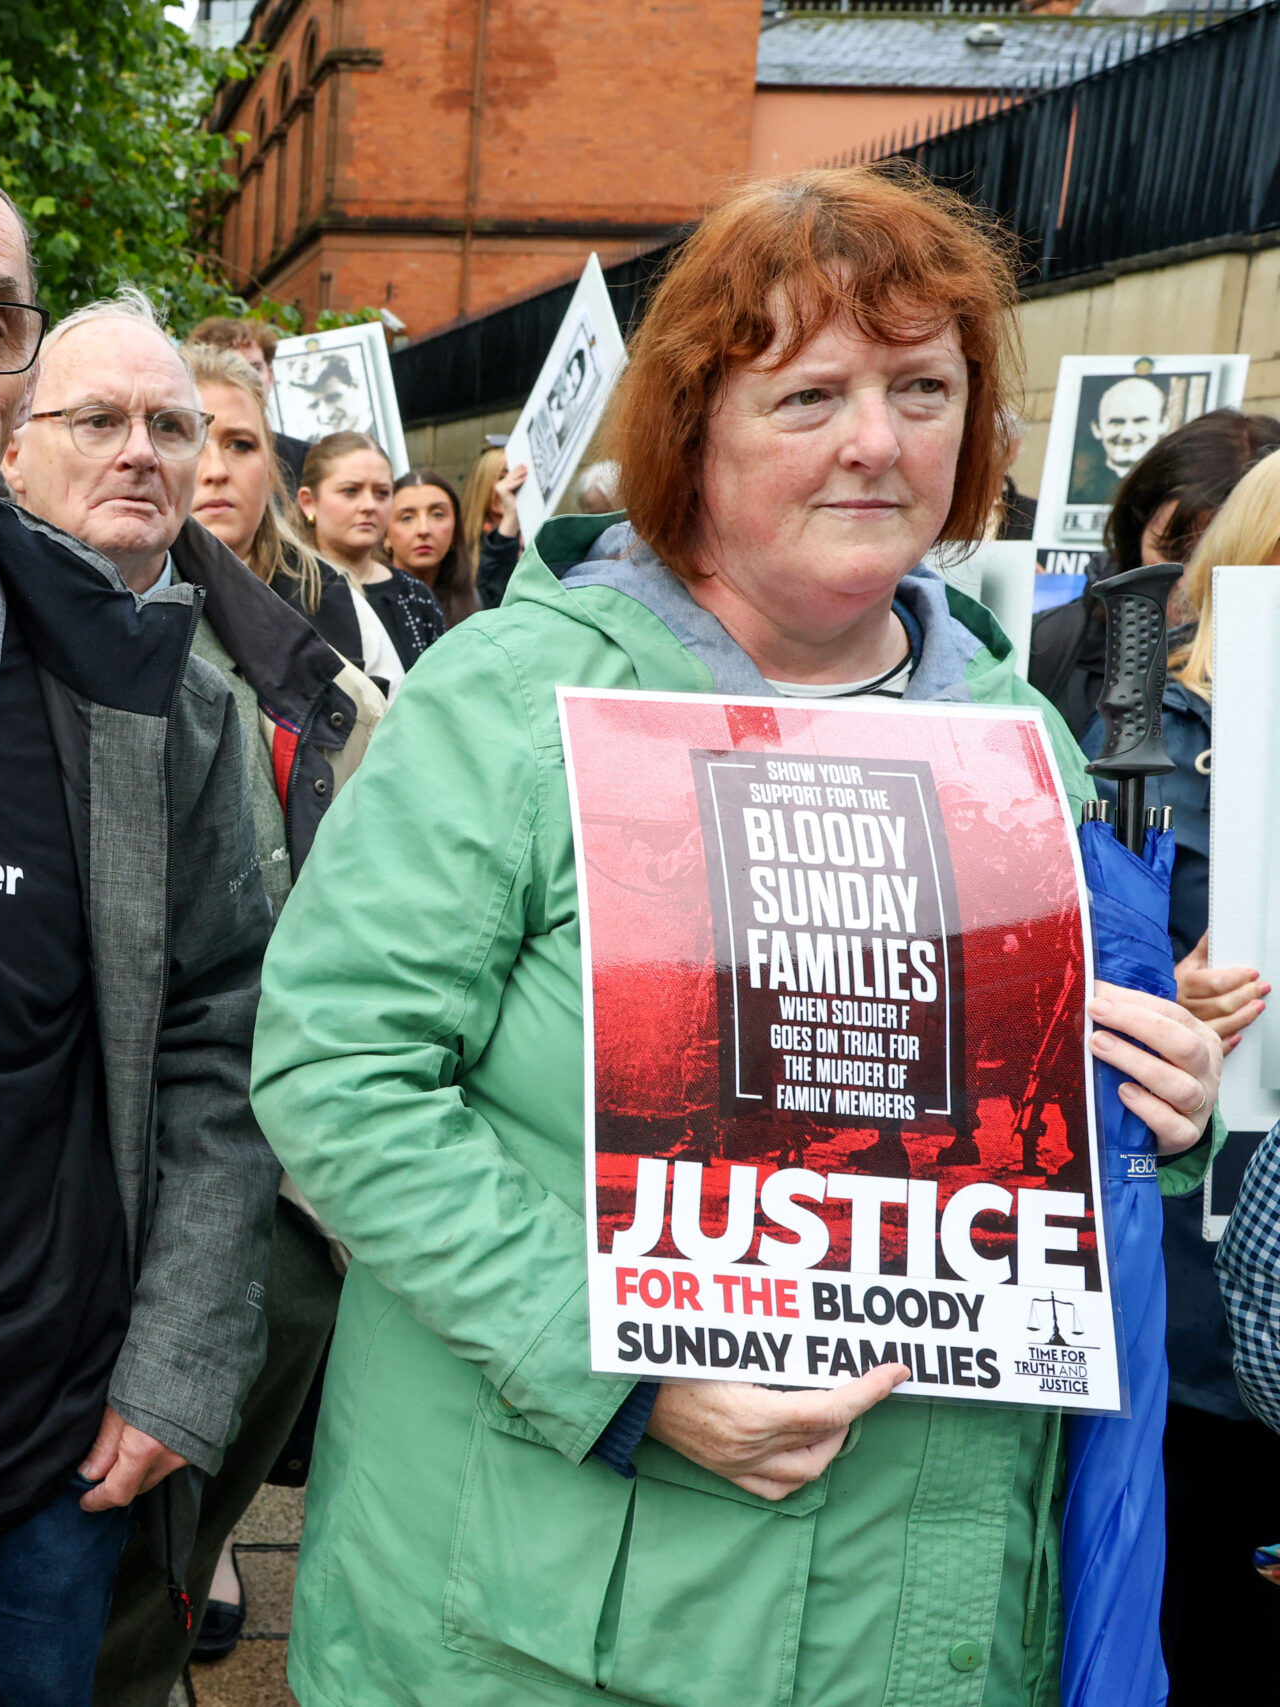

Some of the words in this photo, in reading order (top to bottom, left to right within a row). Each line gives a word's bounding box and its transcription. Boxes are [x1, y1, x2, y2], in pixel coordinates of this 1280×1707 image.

[766, 761, 815, 784] SHOW
[818, 764, 863, 786] YOUR
[749, 783, 821, 808] SUPPORT
[827, 787, 856, 809] FOR
[859, 789, 890, 811] THE
[742, 808, 906, 870] BLOODY
[749, 866, 918, 934] SUNDAY
[747, 928, 938, 1003] FAMILIES
[778, 995, 828, 1024] WHEN
[832, 1000, 899, 1028] SOLDIER
[901, 1006, 910, 1030] F
[770, 1024, 812, 1052] GOES
[816, 1027, 838, 1054] ON
[842, 1030, 886, 1058] TRIAL
[889, 1034, 920, 1060] FOR
[783, 1055, 812, 1082] THE
[816, 1057, 884, 1088] MURDER
[888, 1063, 907, 1089] OF
[776, 1084, 831, 1114] FAMILY
[835, 1089, 915, 1120] MEMBERS
[611, 1158, 1087, 1291] JUSTICE
[615, 1266, 704, 1311] FOR
[714, 1274, 800, 1318] THE
[812, 1282, 985, 1332] BLOODY
[618, 1321, 792, 1372] SUNDAY
[806, 1335, 1001, 1389] FAMILIES
[1015, 1361, 1055, 1375] TRUTH
[1060, 1366, 1087, 1378] AND
[1028, 1347, 1058, 1361] TIME
[1061, 1350, 1086, 1363] FOR
[1039, 1378, 1088, 1393] JUSTICE
